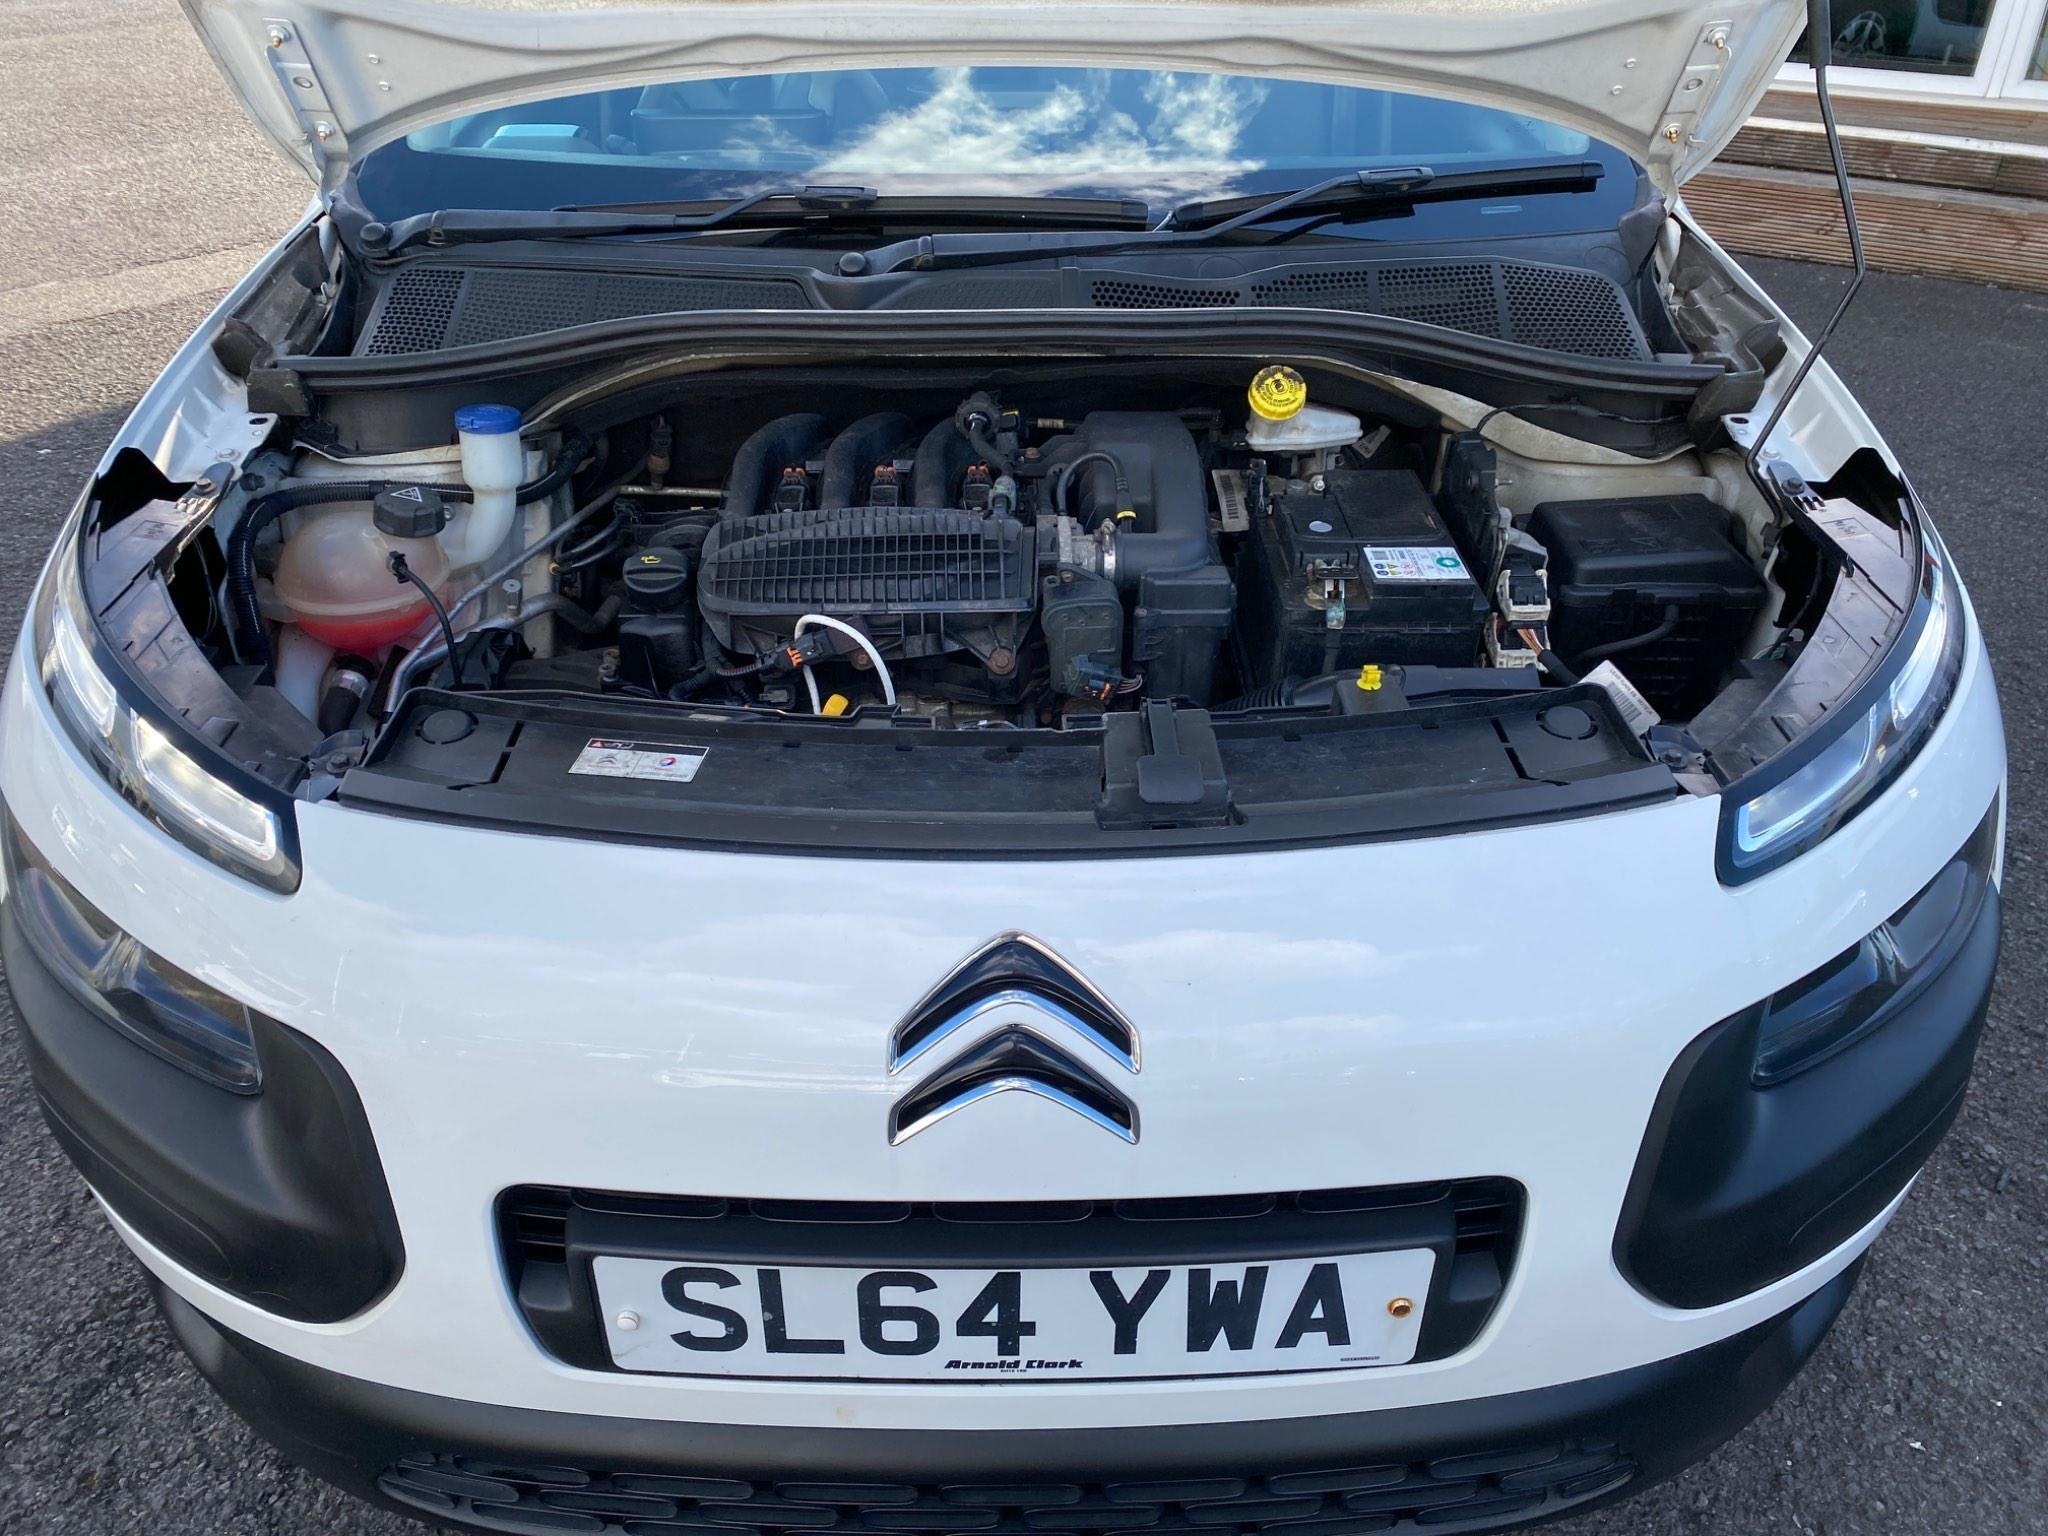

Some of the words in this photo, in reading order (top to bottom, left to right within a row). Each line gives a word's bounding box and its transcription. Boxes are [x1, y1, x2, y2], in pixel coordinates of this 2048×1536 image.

[661, 1266, 1036, 1357] SL64
[1089, 1262, 1351, 1355] YWA
[945, 1359, 1021, 1369] Arnold
[1025, 1358, 1084, 1369] Clark
